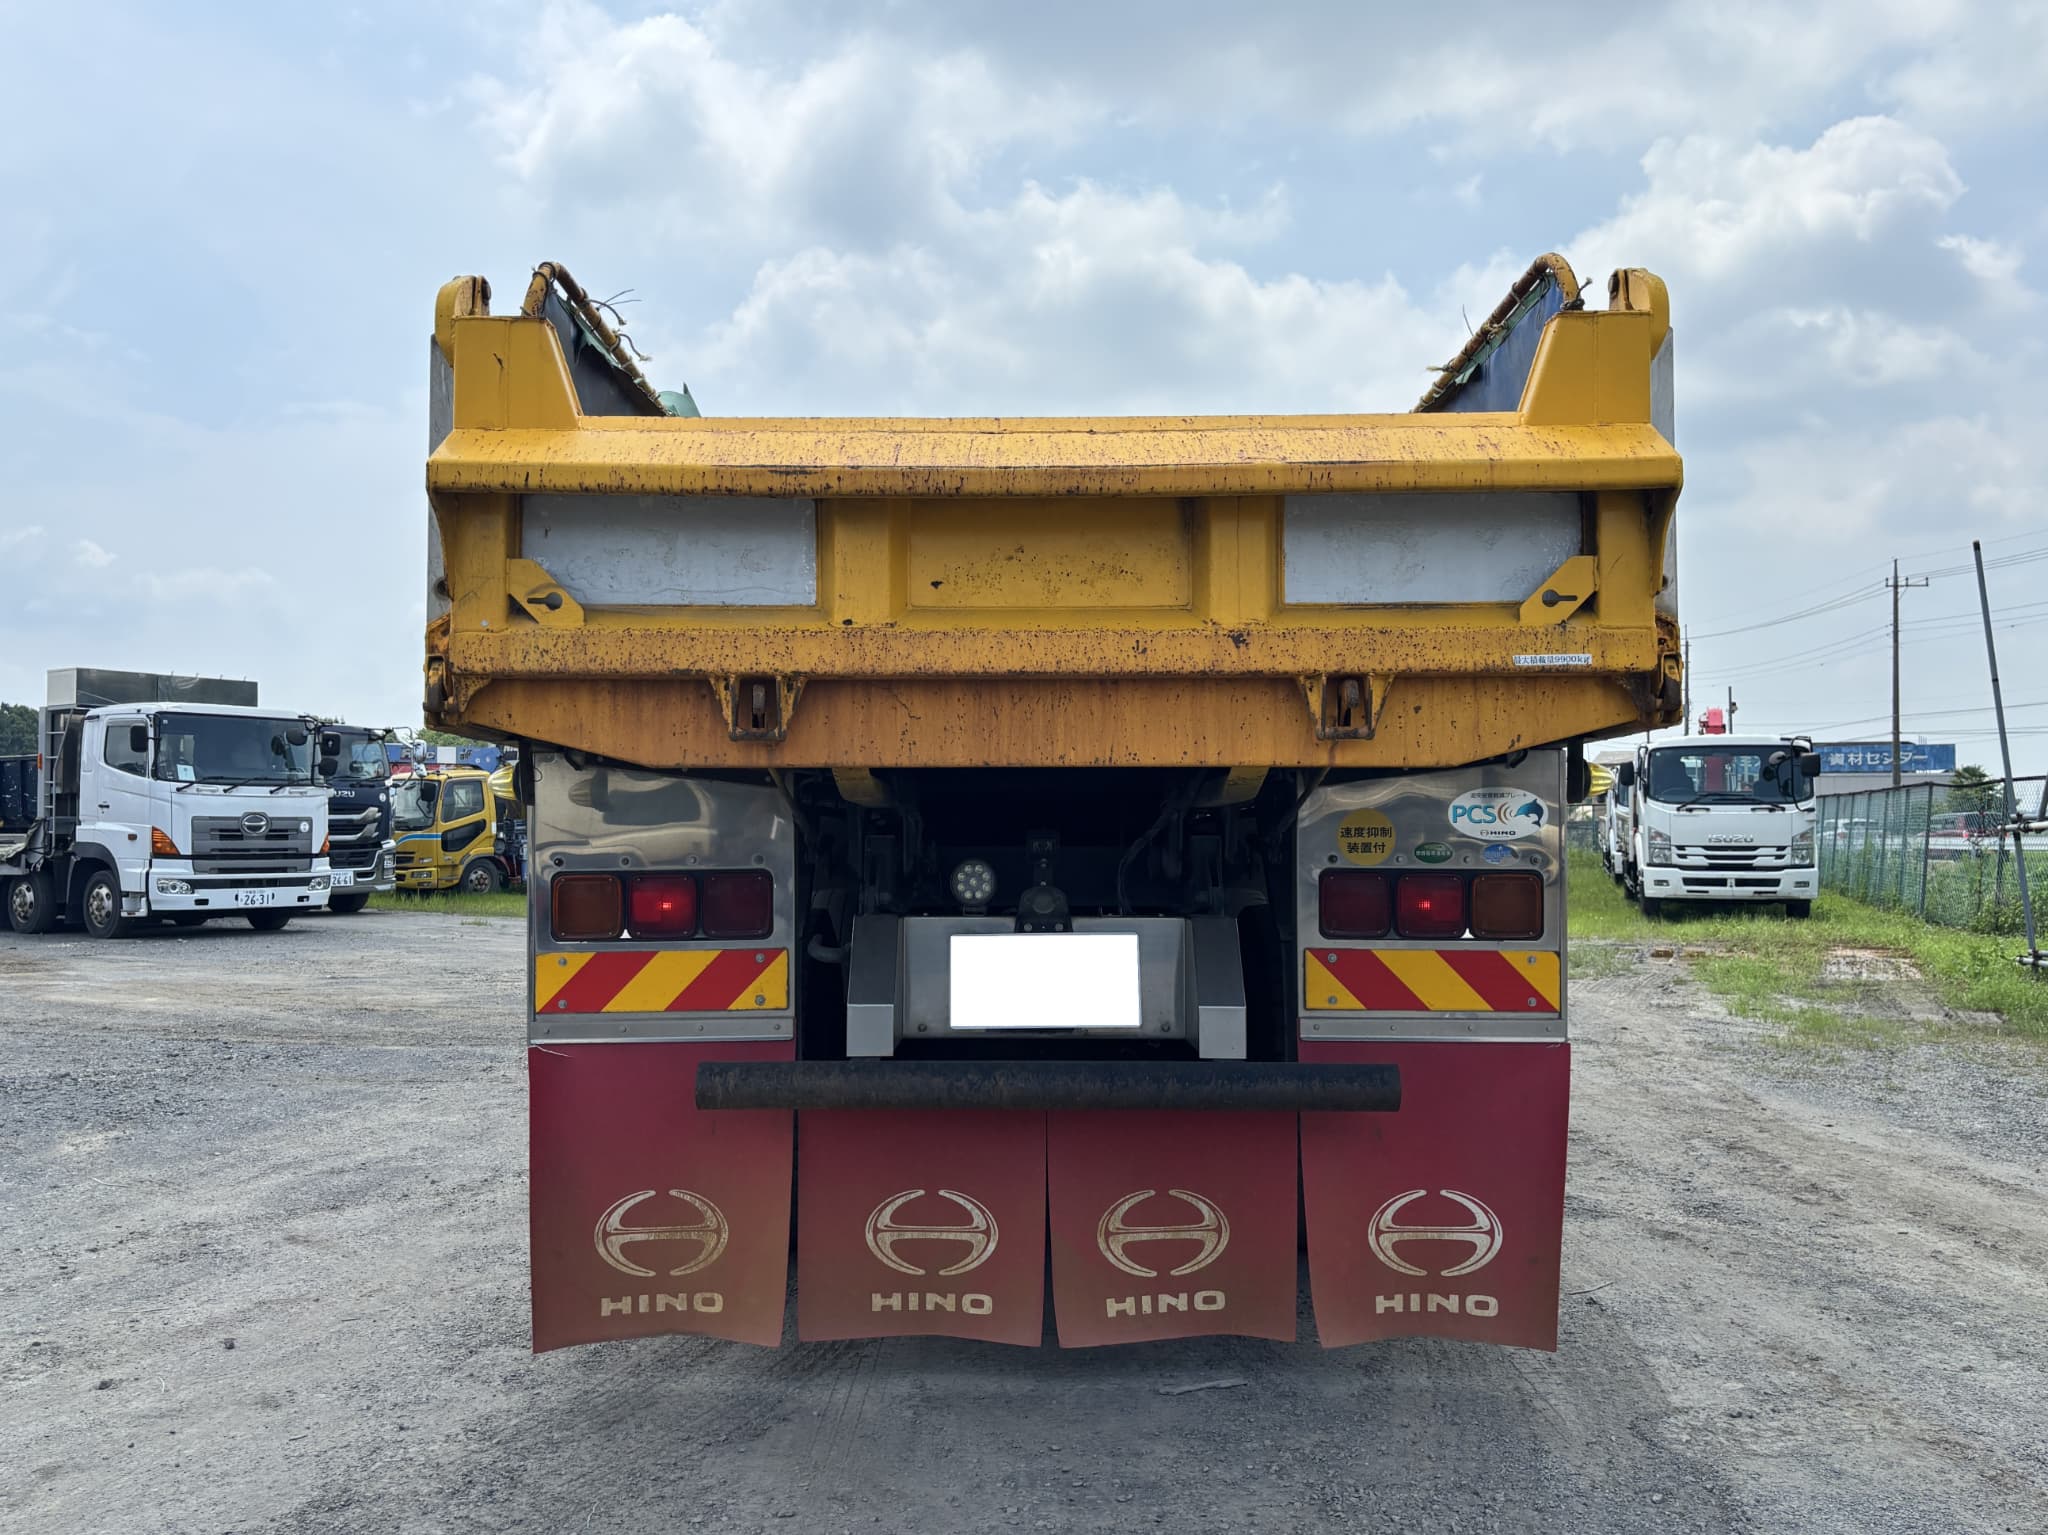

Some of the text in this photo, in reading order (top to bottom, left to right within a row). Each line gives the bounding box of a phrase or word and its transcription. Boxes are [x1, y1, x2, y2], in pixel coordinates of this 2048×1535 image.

[1452, 805, 1497, 824] PCS
[1340, 826, 1392, 839] 速度抑制
[1708, 834, 1754, 843] ISUZU
[1346, 842, 1386, 854] 装置付
[601, 1292, 724, 1317] HINO
[871, 1292, 993, 1315] HINO
[1105, 1290, 1226, 1318] HINO
[1375, 1293, 1499, 1317] HINO
